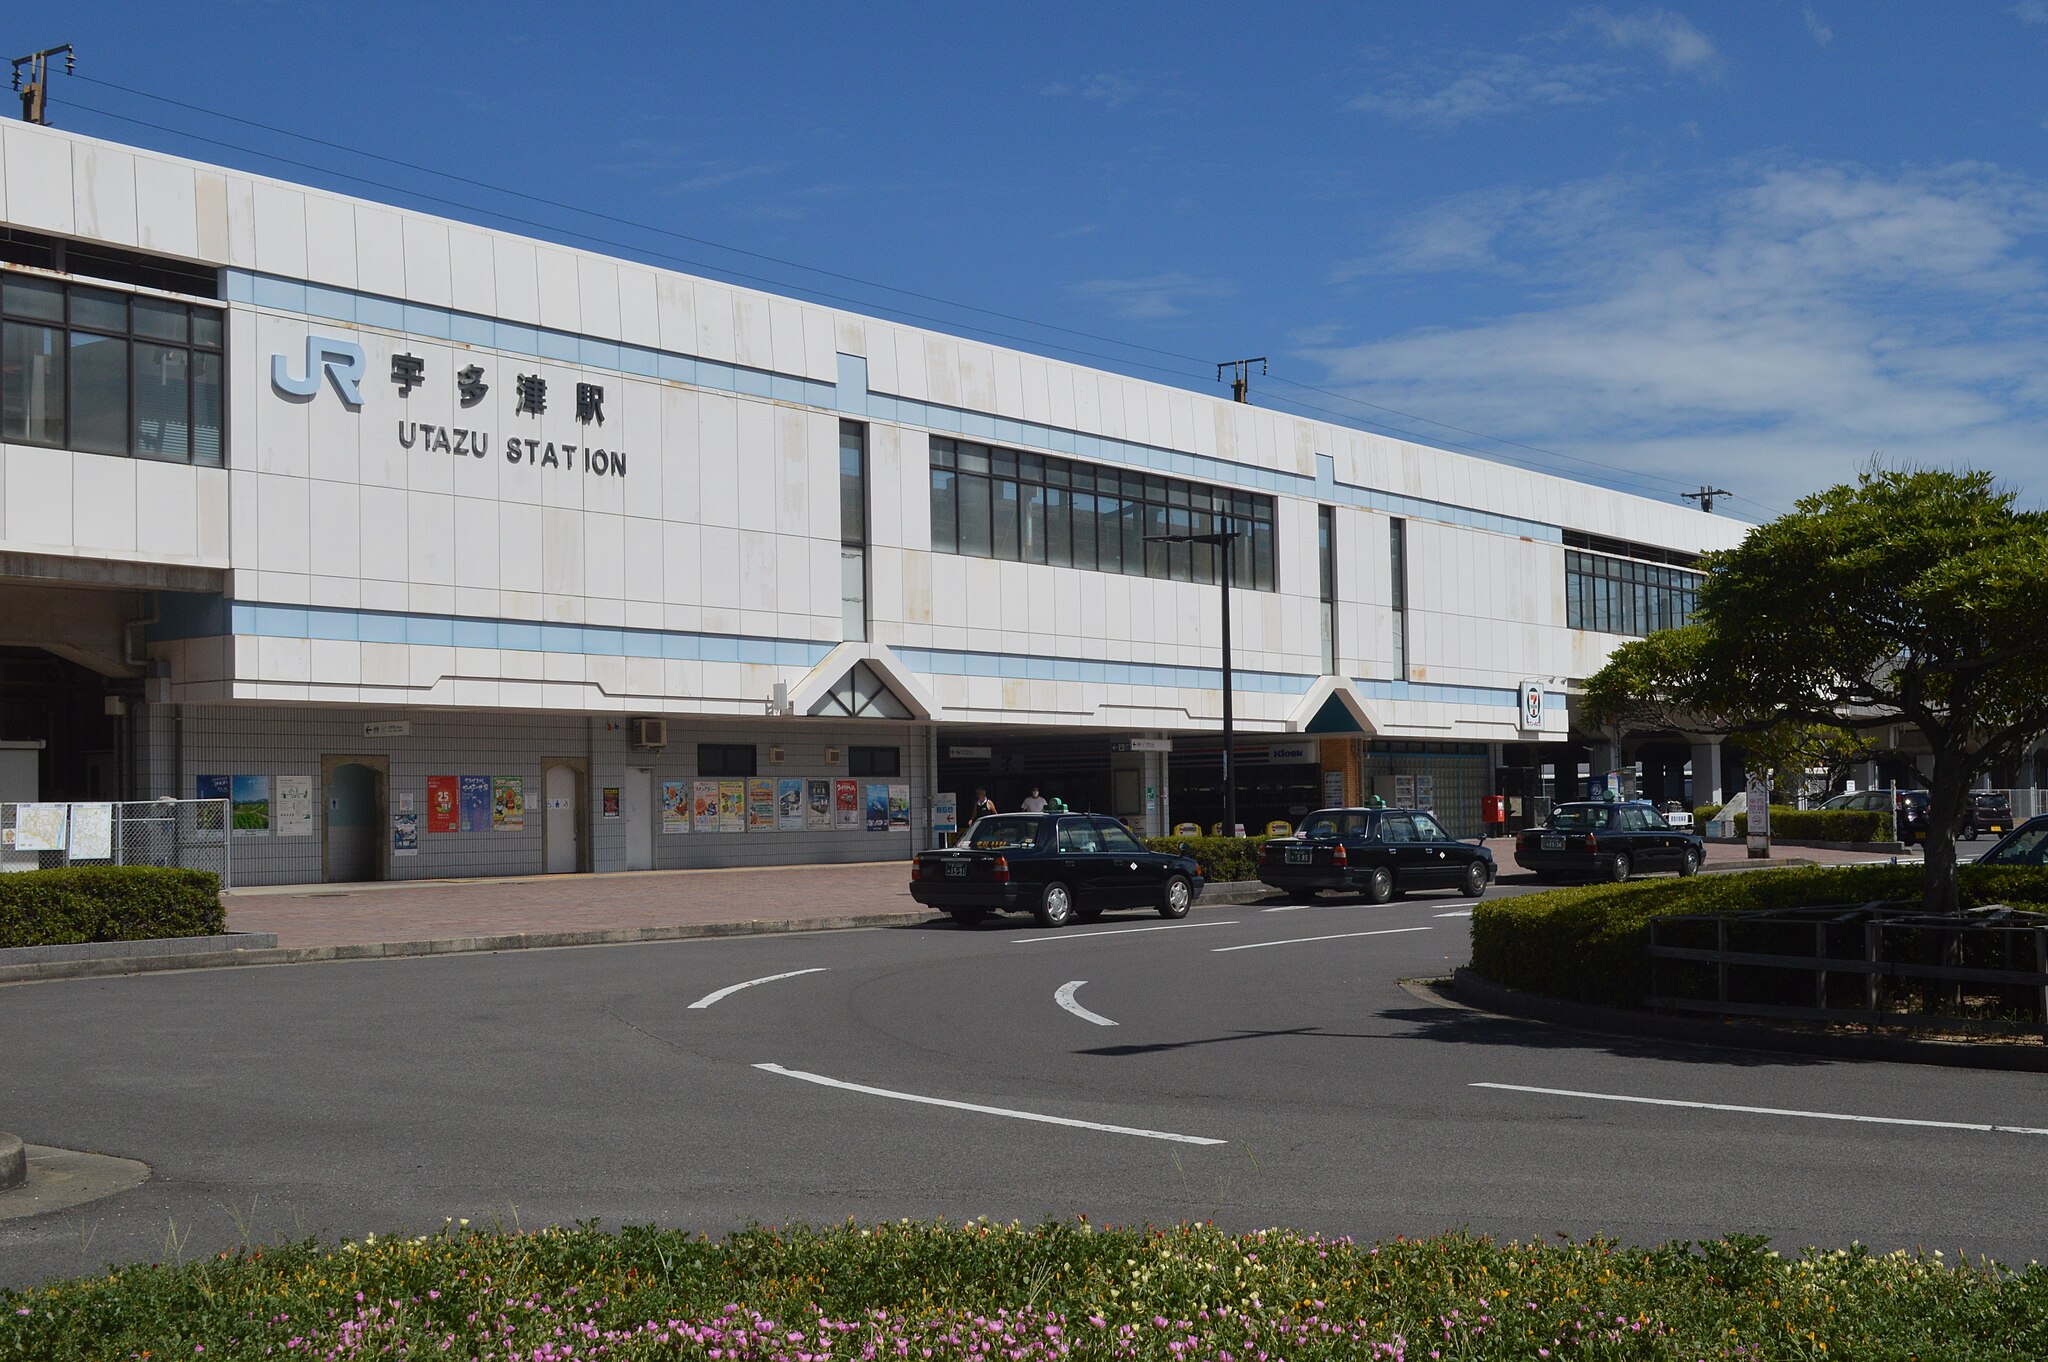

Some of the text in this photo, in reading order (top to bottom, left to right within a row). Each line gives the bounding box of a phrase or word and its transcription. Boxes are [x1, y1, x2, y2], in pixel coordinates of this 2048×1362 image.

[271, 335, 366, 412] JR
[390, 352, 606, 428] 宇多津駅
[398, 420, 627, 477] UTAZU STATION
[1274, 750, 1304, 758] Kiosk
[437, 791, 449, 802] 25
